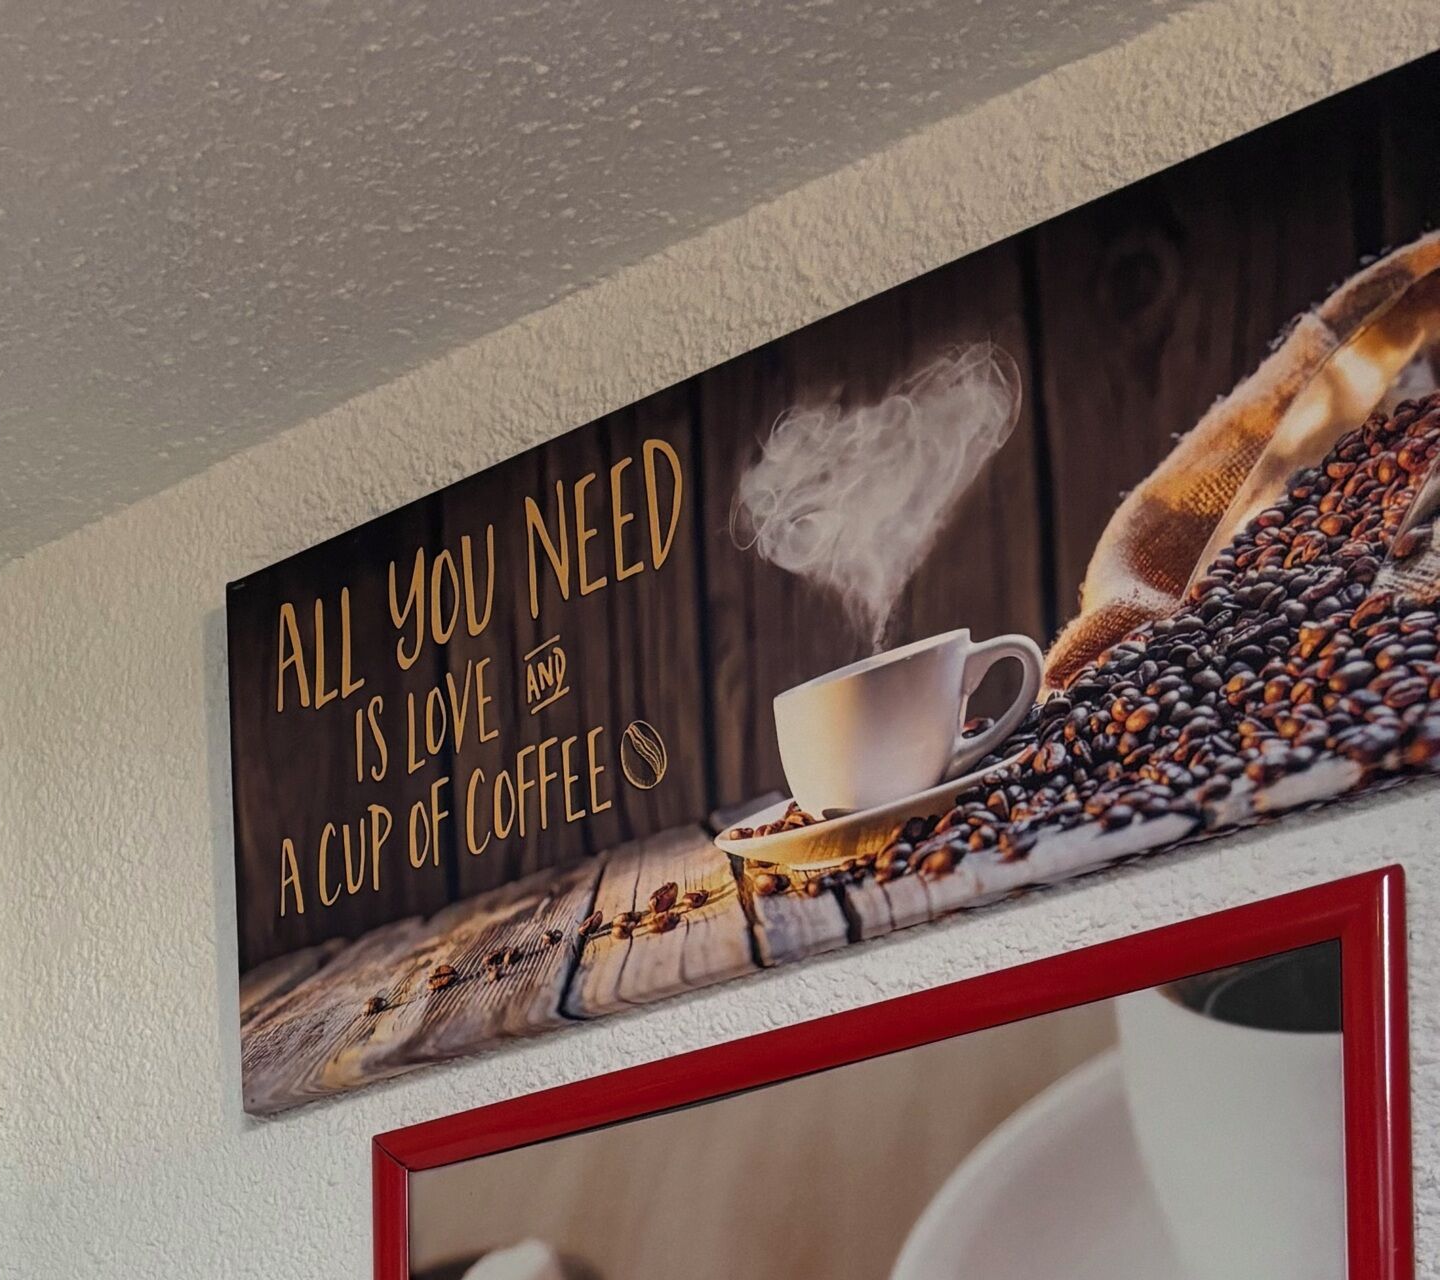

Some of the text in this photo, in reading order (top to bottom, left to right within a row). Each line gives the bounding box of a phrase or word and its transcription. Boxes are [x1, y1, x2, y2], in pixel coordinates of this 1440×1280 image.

[277, 438, 683, 712] ALL YOU NEED
[355, 646, 566, 783] IS LOVE AND
[280, 725, 612, 917] A CUP OF COFFEE
